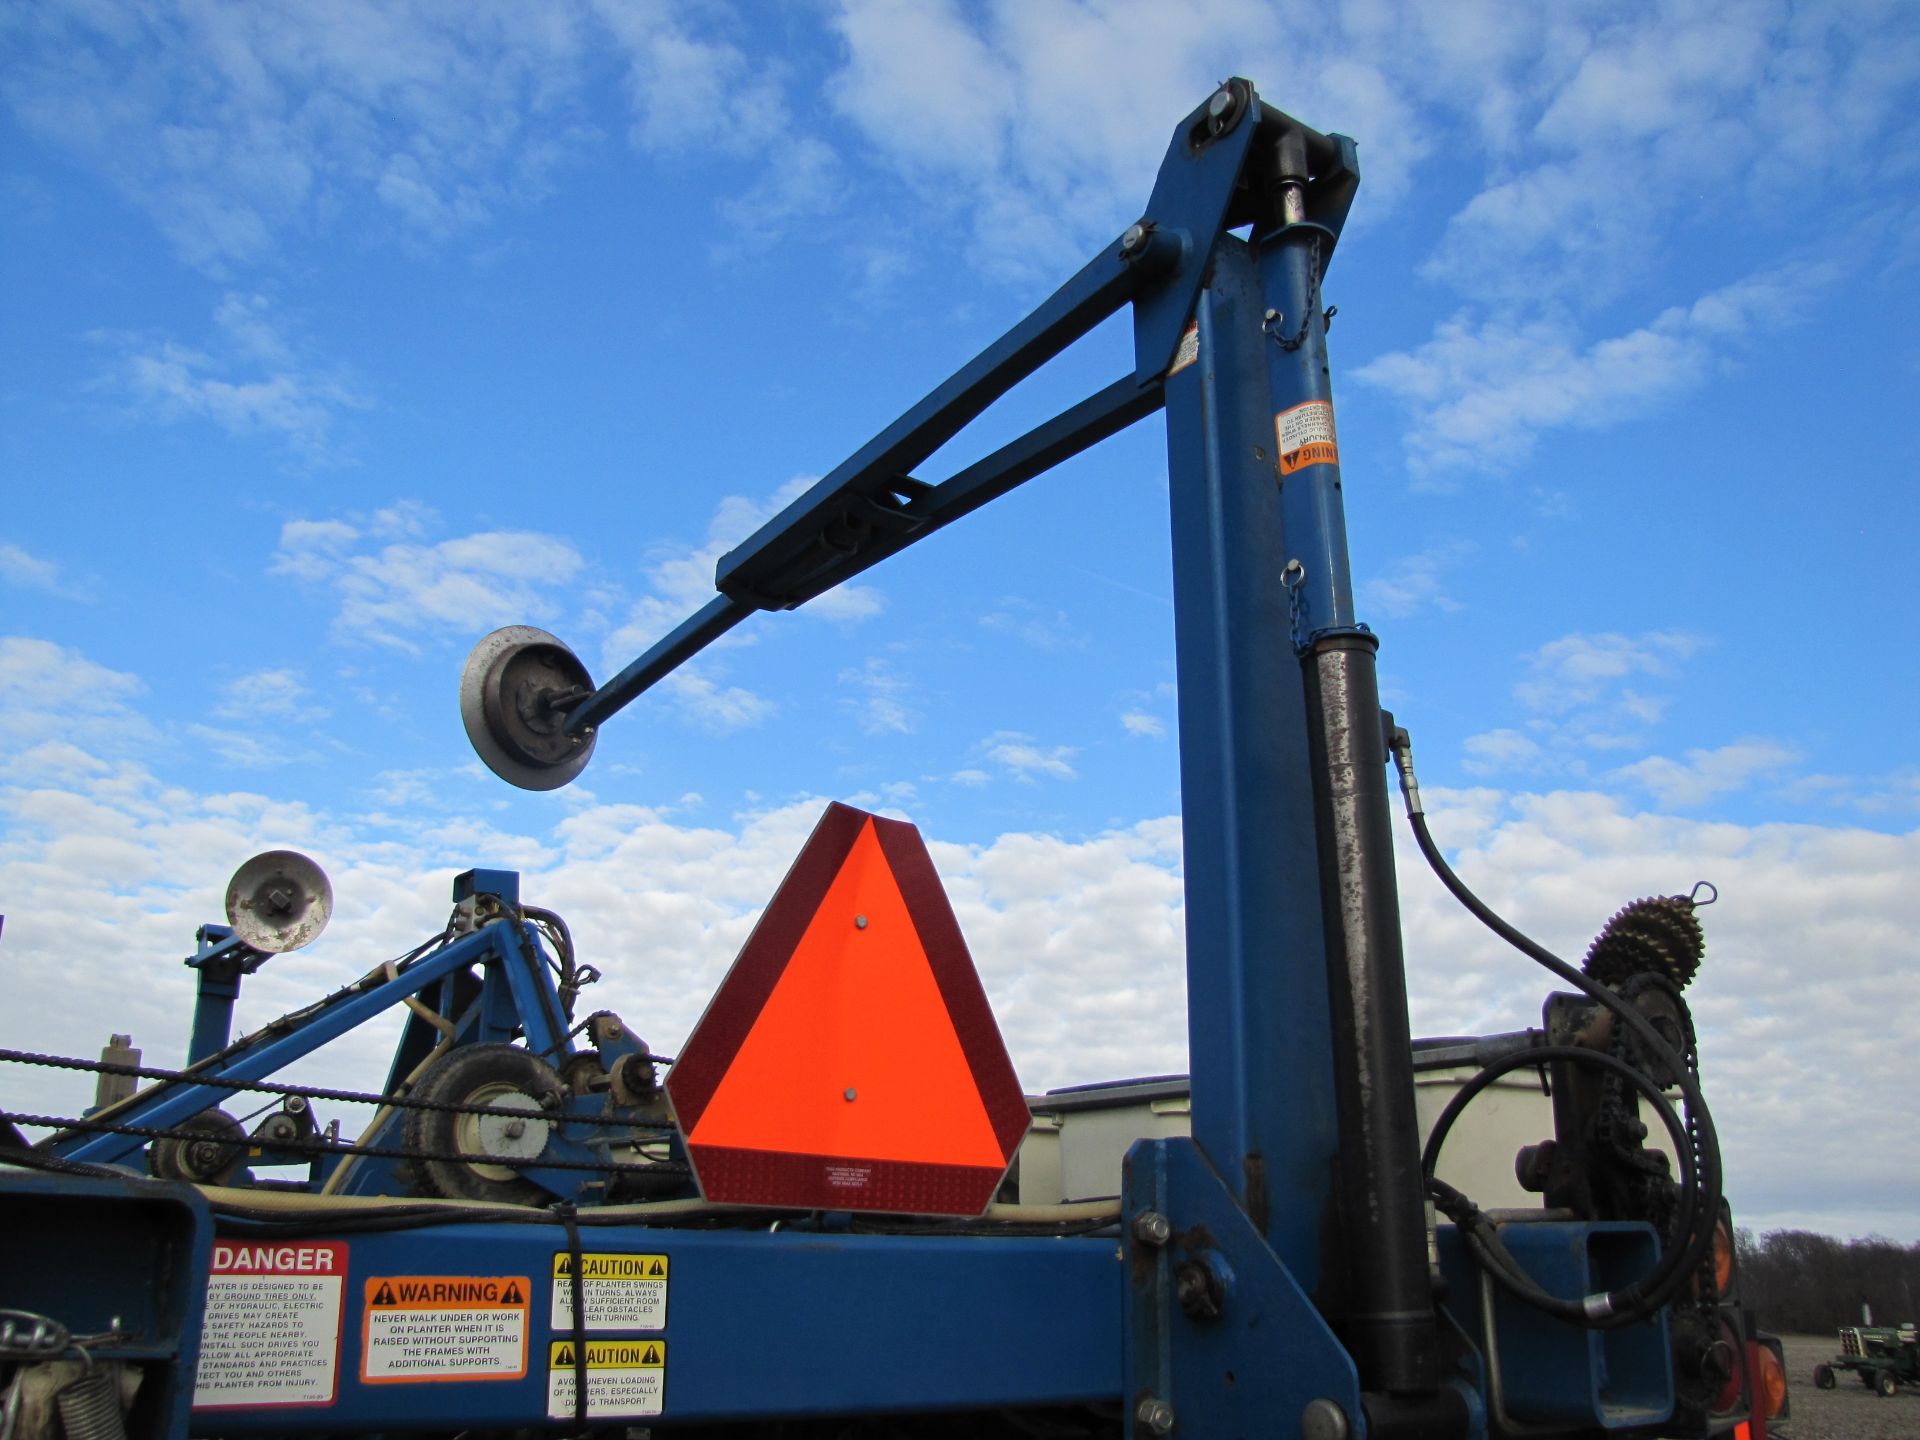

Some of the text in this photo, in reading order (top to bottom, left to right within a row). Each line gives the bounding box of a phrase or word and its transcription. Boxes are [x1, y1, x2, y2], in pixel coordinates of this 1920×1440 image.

[214, 1248, 333, 1270] DANGER
[399, 1283, 498, 1302] WARNING
[410, 1314, 437, 1322] WALK
[476, 1313, 489, 1321] OR
[492, 1313, 520, 1321] WORK
[390, 1326, 405, 1334] ON
[407, 1325, 451, 1333] PLANTER
[484, 1324, 493, 1332] IT
[495, 1324, 504, 1332] IS
[374, 1335, 518, 1345] RAISED WITHOUT SUPPORTING
[403, 1346, 490, 1356] THE FRAMES WITH
[587, 1349, 639, 1363] AUTION
[202, 1361, 256, 1369] STANDARDS
[388, 1359, 446, 1368] ADDITIONAL
